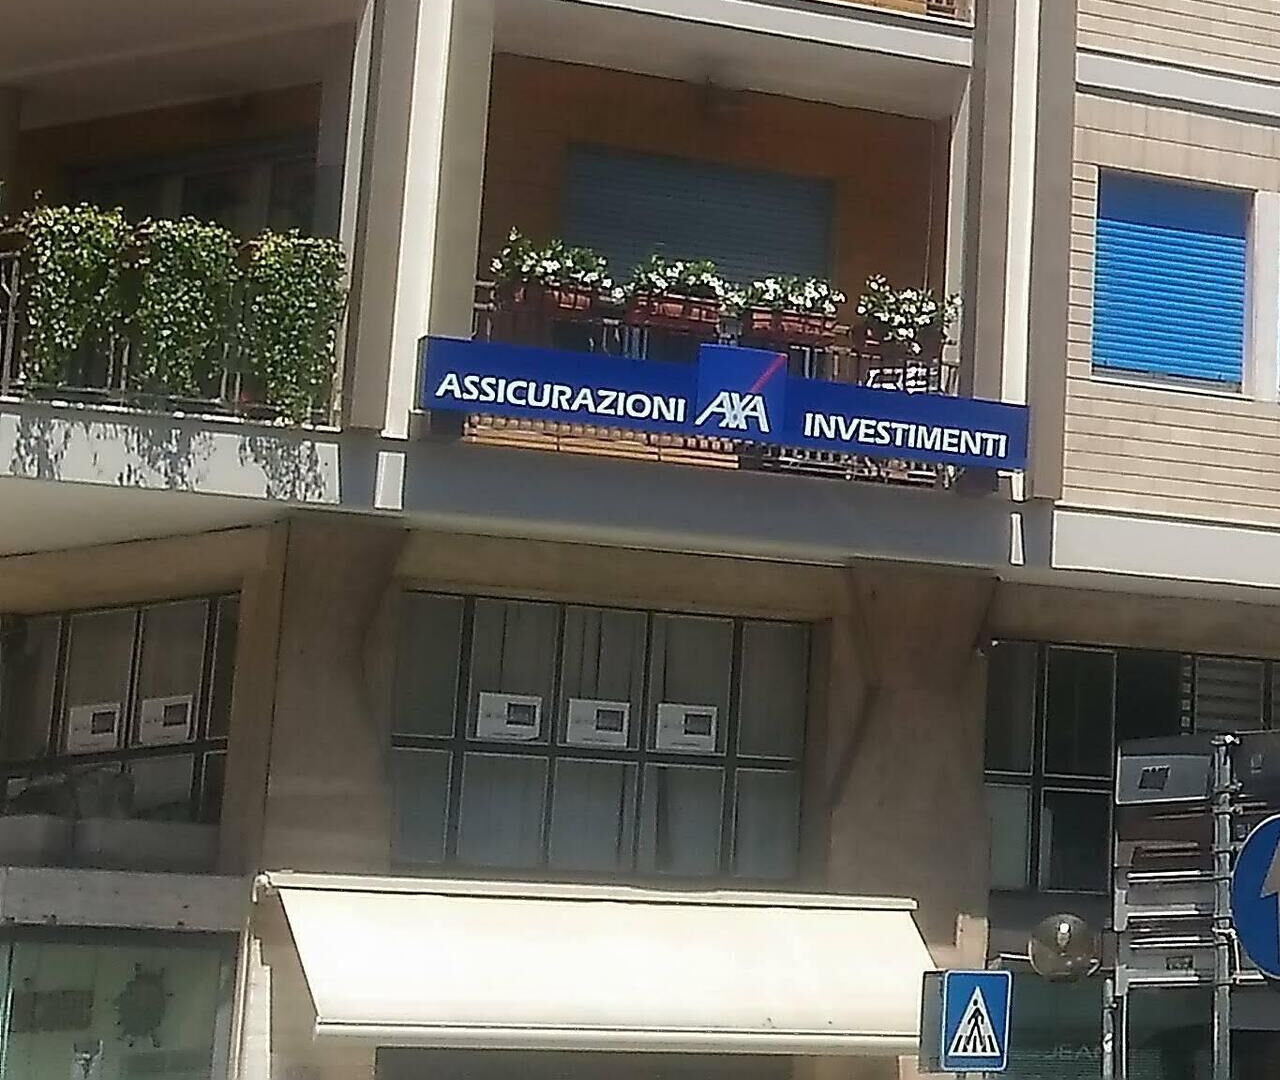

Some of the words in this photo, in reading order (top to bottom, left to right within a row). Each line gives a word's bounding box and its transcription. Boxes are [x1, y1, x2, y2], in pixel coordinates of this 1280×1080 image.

[435, 373, 686, 422] ASSICURAZIONI
[694, 390, 770, 433] AXA
[803, 412, 1007, 458] INVESTIMENTI
